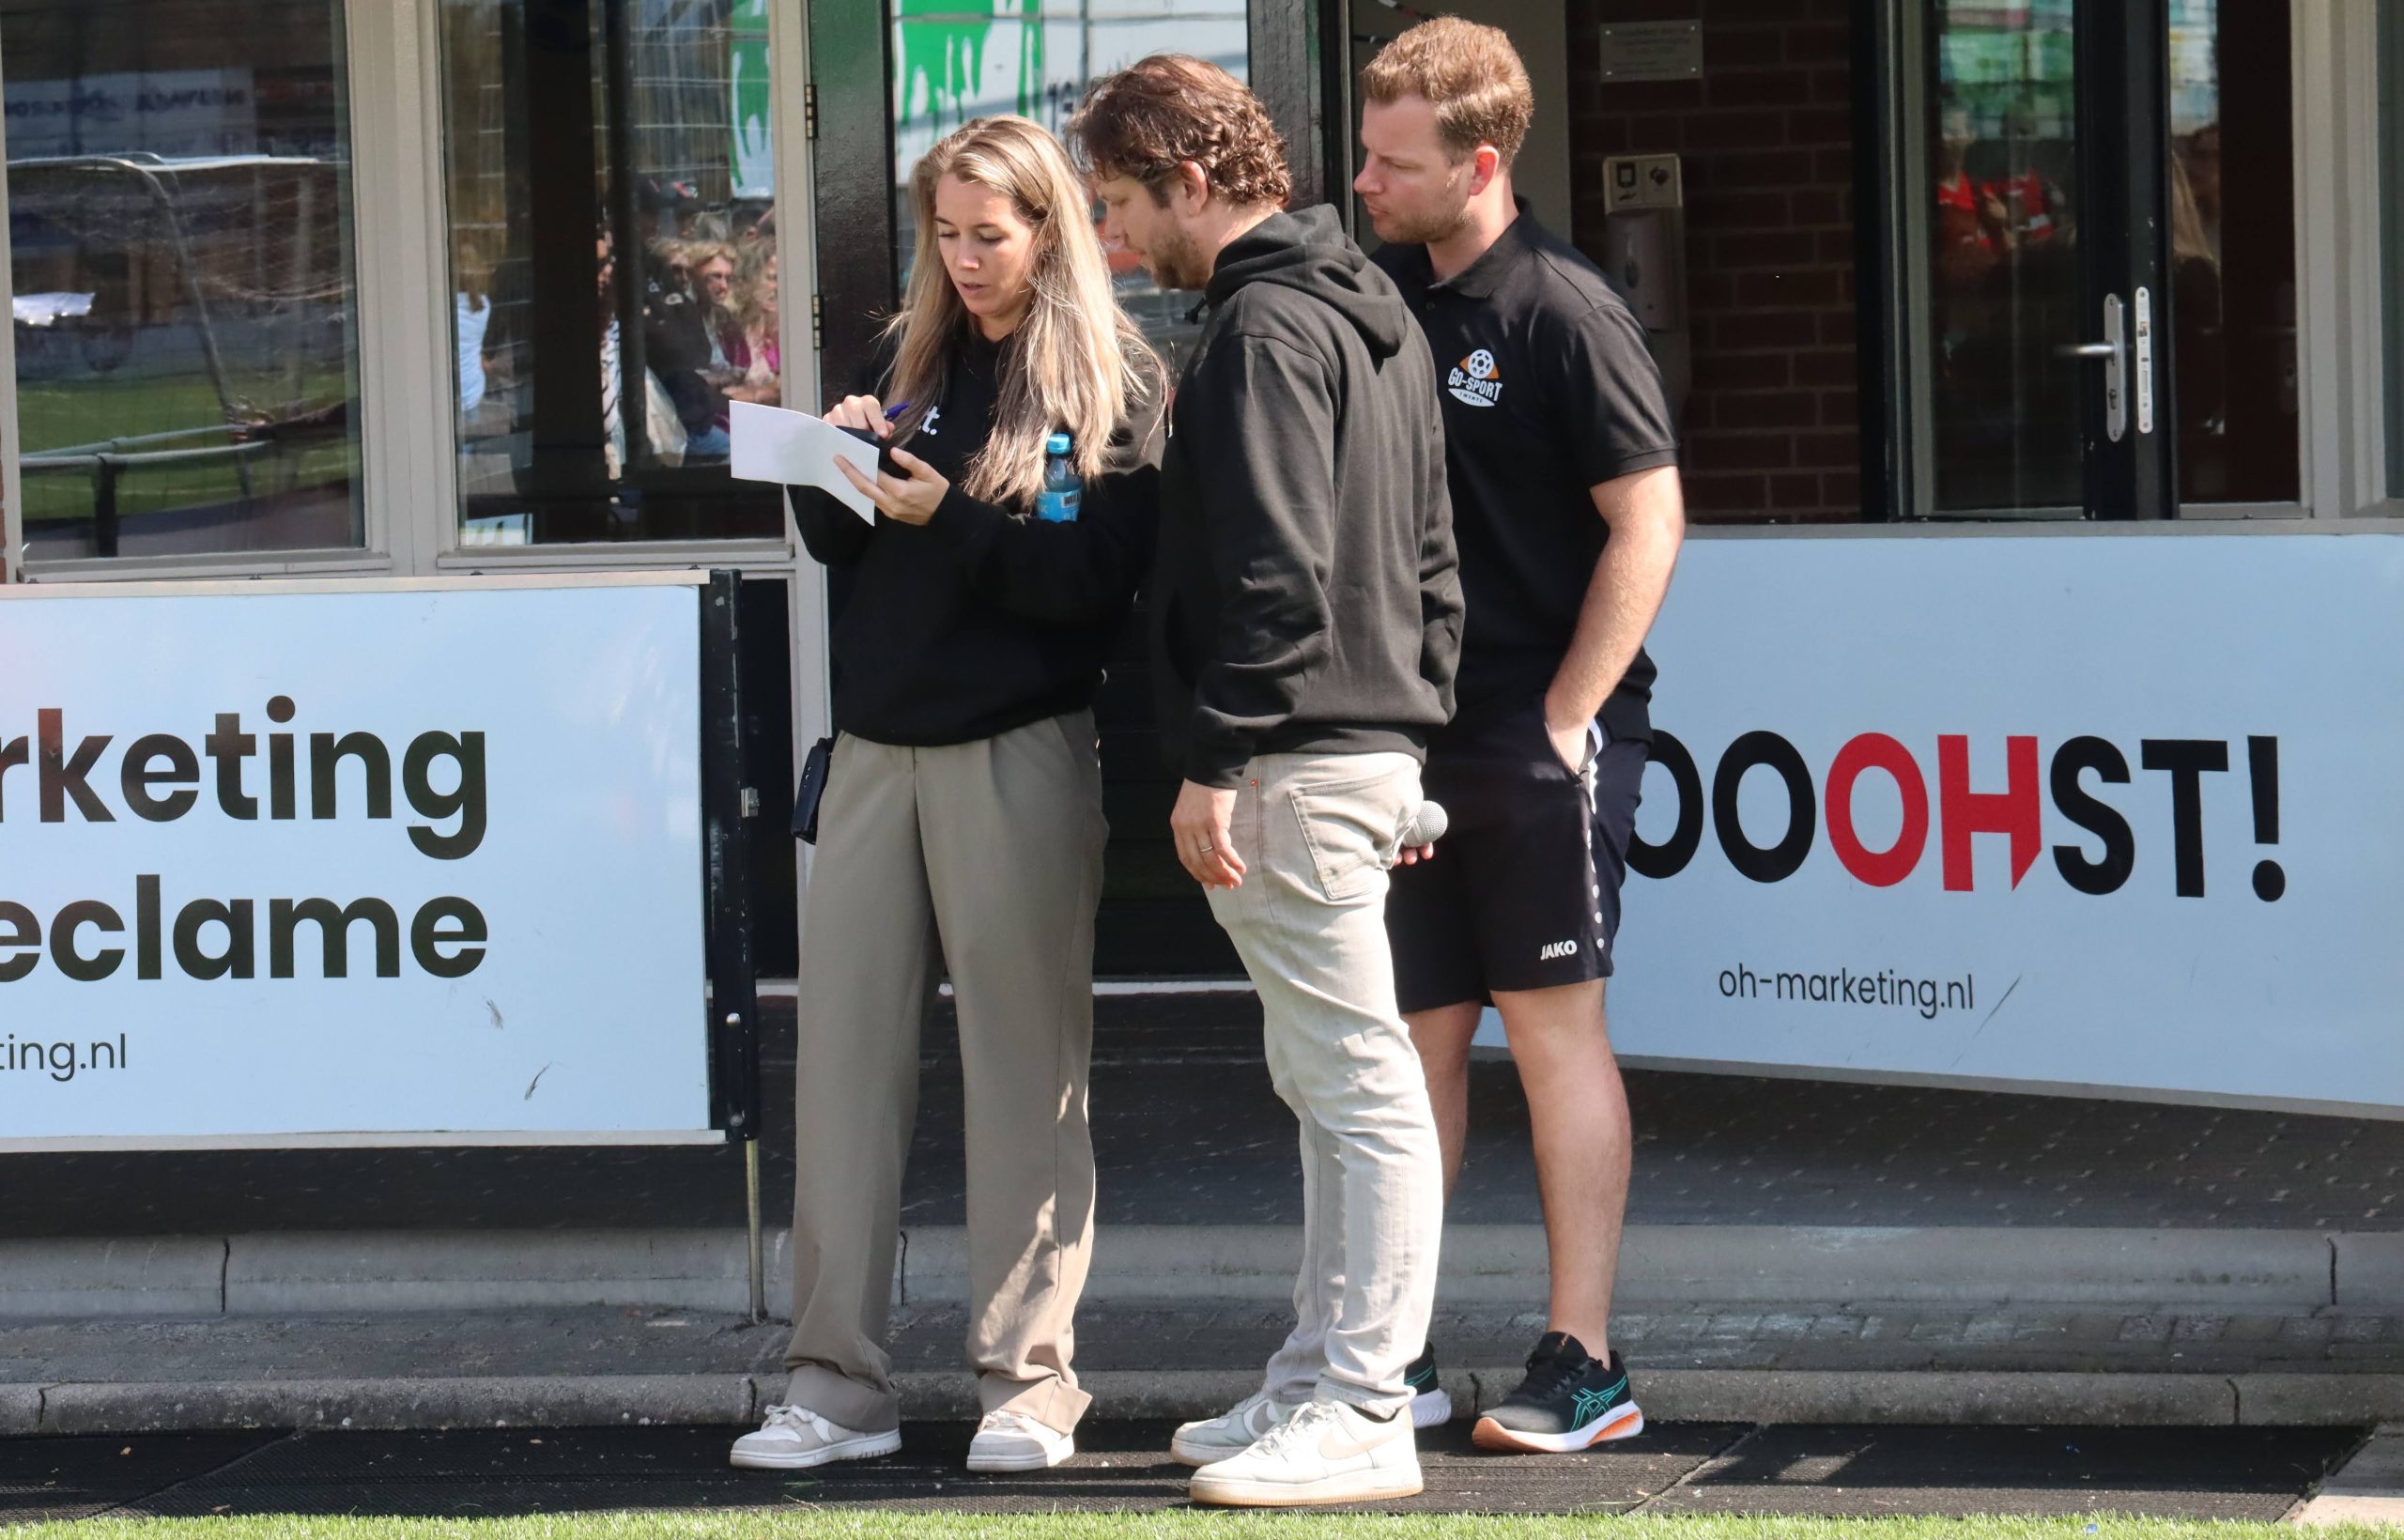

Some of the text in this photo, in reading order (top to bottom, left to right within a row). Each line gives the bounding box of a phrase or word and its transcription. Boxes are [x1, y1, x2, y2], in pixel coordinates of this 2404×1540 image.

[1447, 367, 1503, 401] GO-SPORT
[1540, 940, 1578, 961] JAKO
[1718, 962, 1974, 1020] oh-marketing.nl
